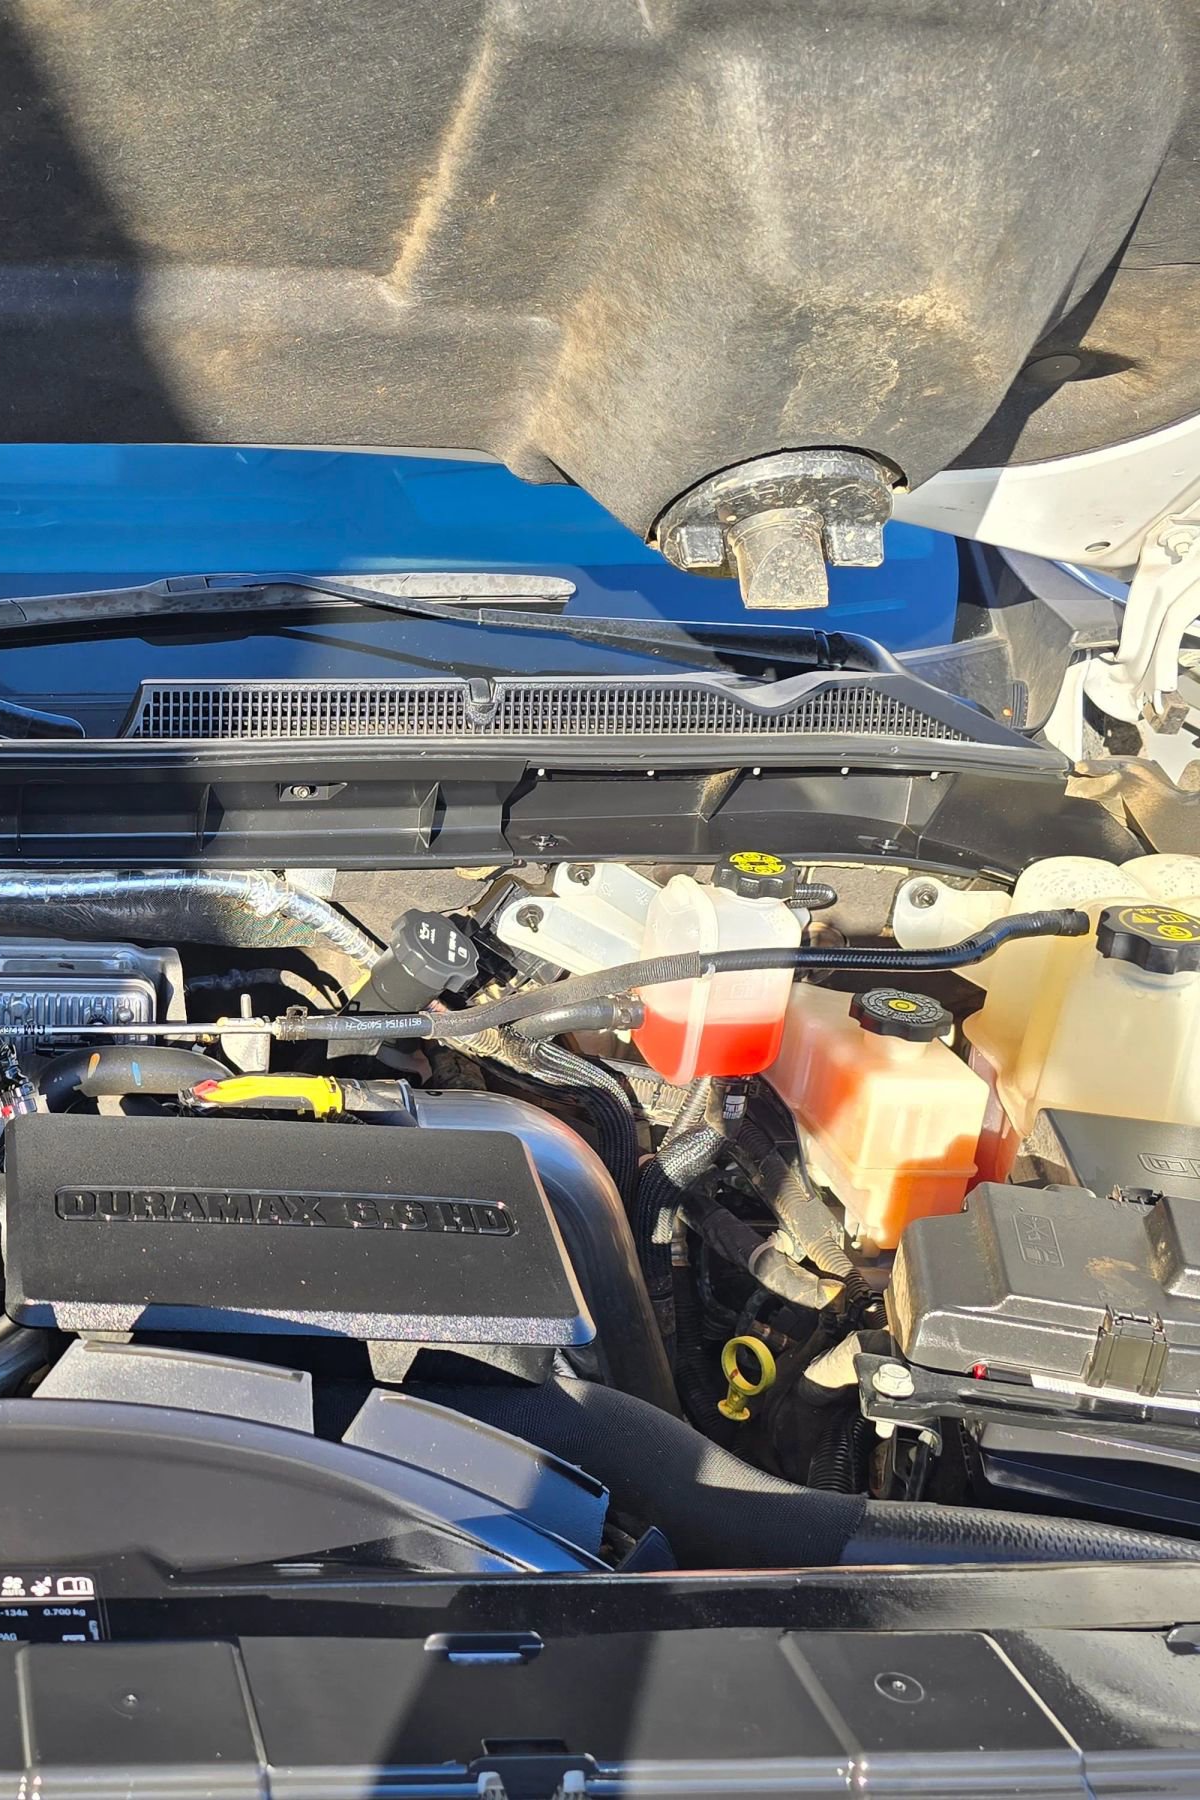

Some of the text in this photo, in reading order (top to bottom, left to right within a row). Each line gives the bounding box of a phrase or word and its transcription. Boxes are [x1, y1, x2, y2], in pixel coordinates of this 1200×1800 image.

[62, 1190, 512, 1236] DURAMAX 6.6 HD
[43, 1608, 71, 1616] 0.700
[73, 1608, 87, 1618] kg
